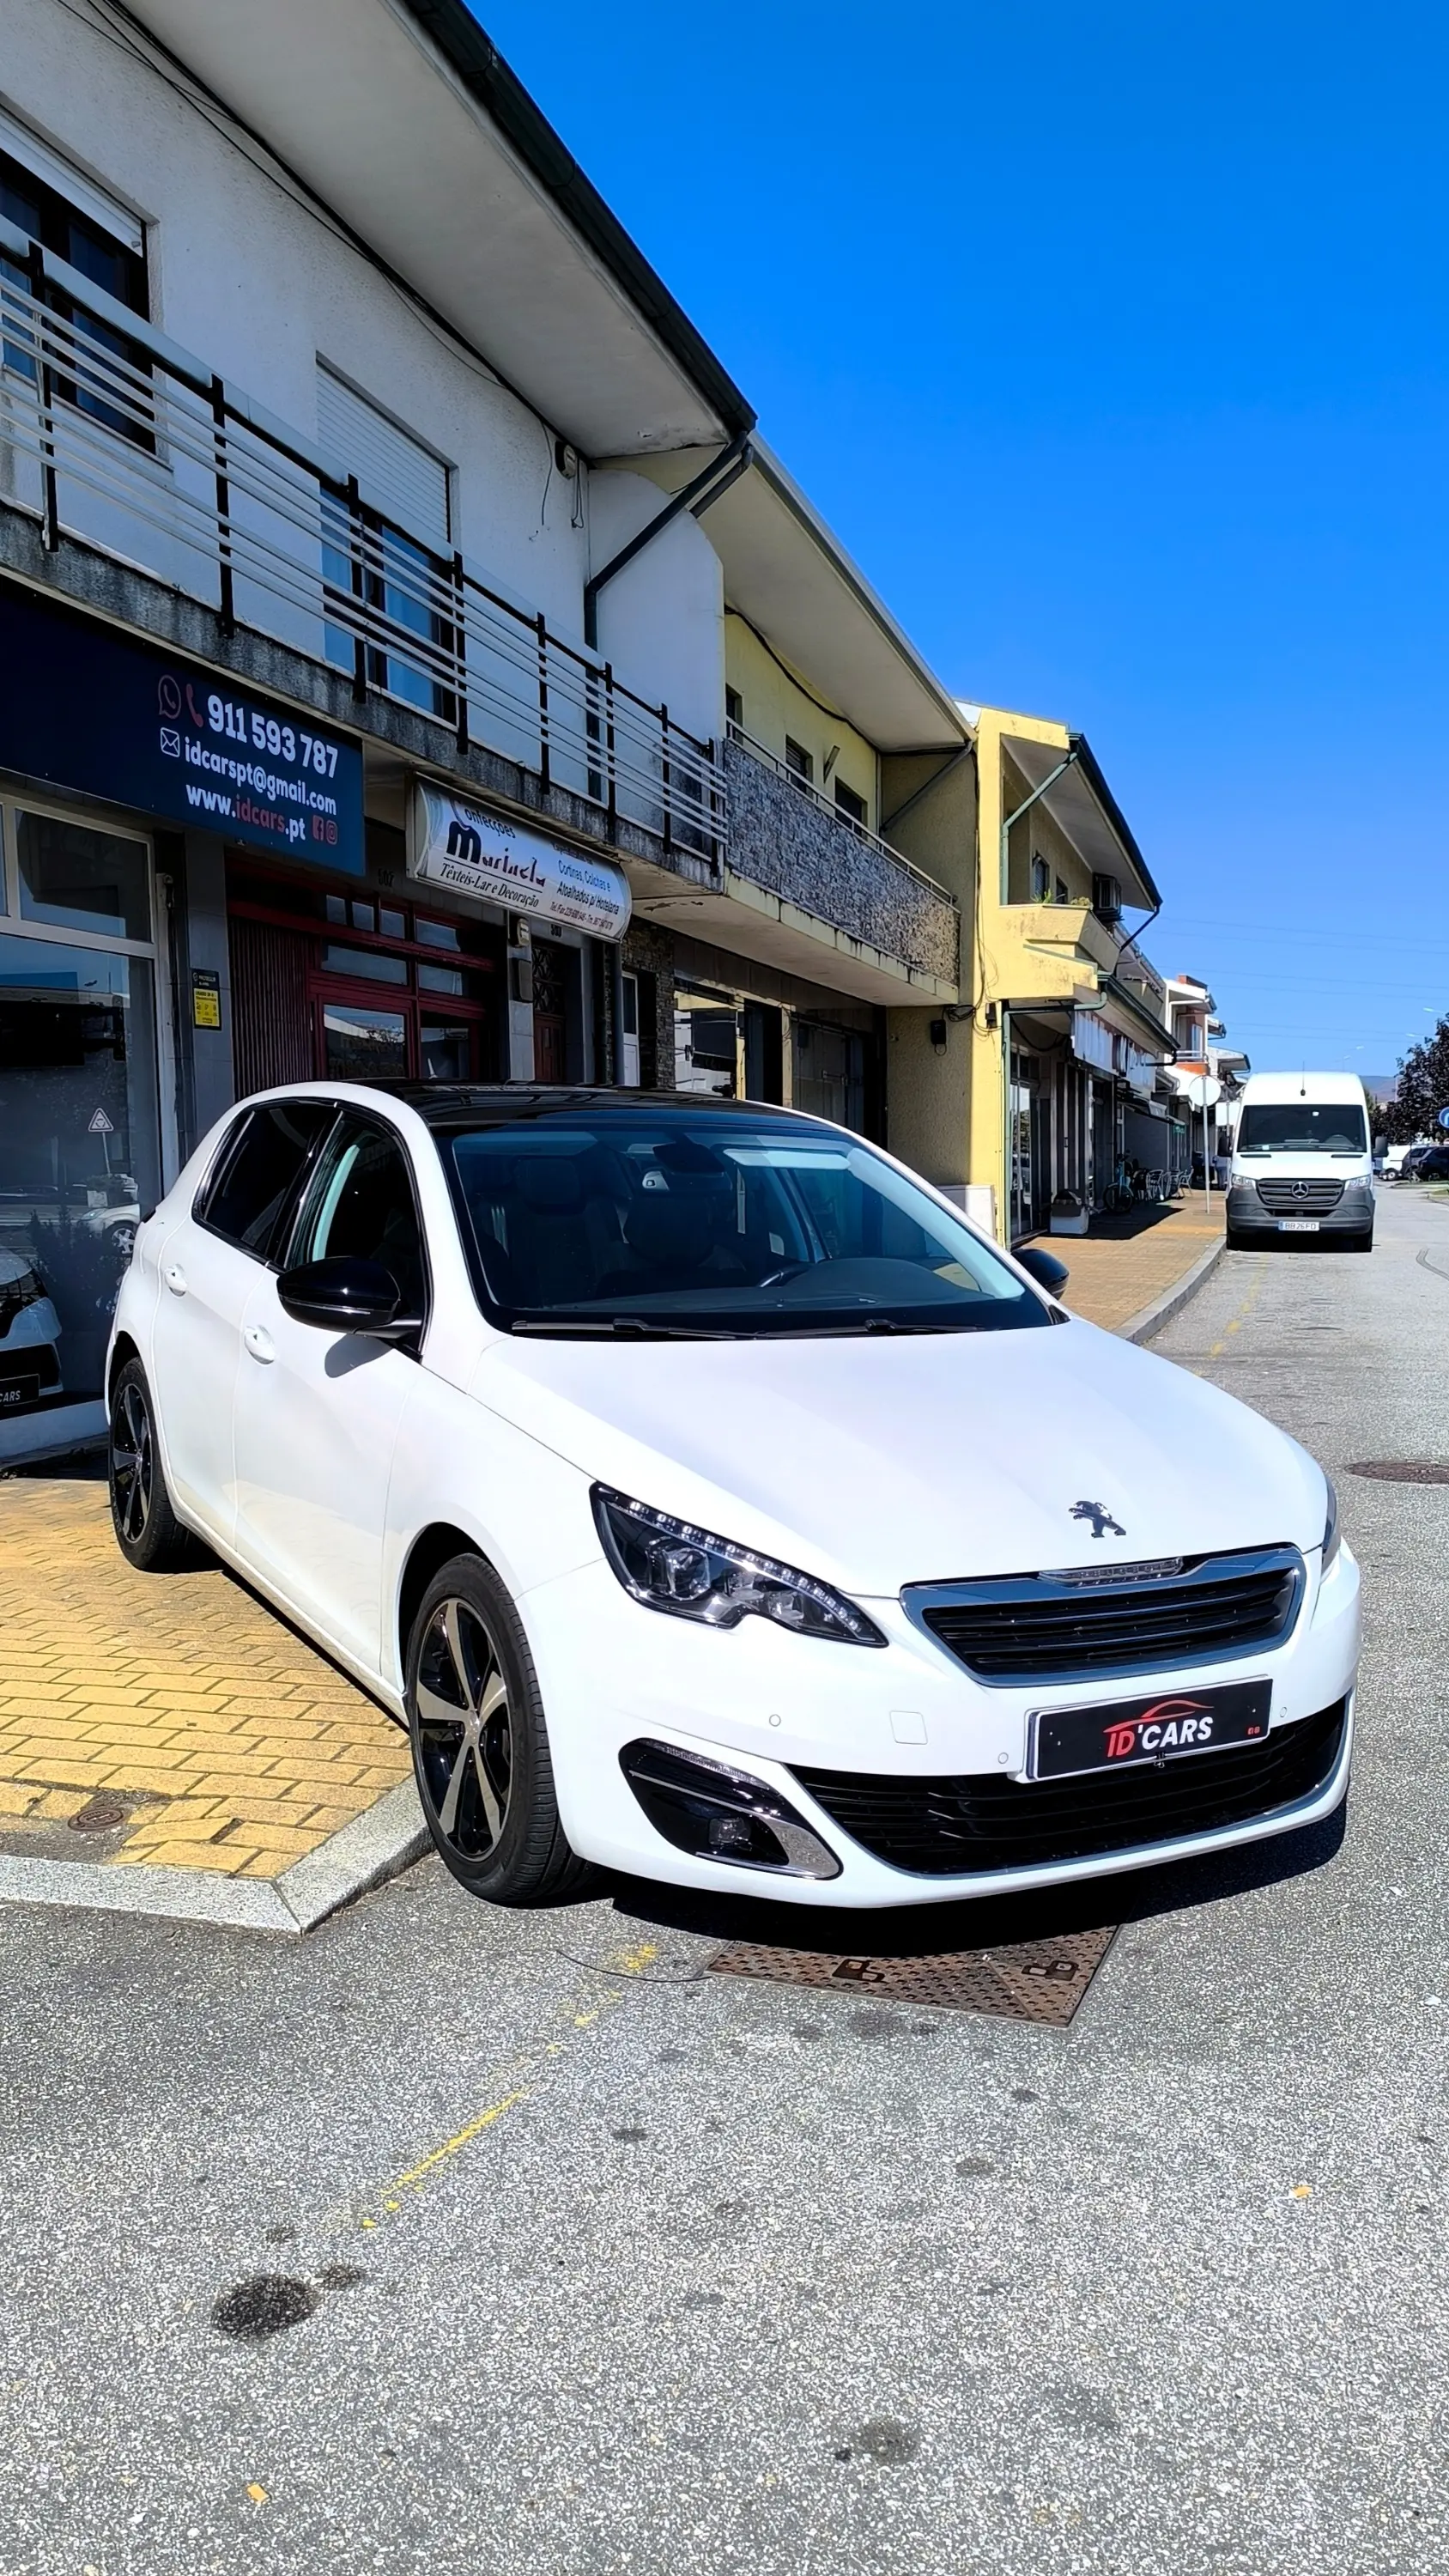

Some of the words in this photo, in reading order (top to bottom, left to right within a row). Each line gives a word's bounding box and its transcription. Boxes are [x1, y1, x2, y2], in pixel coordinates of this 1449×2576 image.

[208, 695, 247, 744] 911
[252, 711, 295, 762] 593
[300, 732, 338, 779] 787
[185, 737, 337, 816] idcarspt@gmail.com
[185, 784, 306, 843] www.idcars.pt
[440, 862, 490, 893] Têxteis-Lar
[491, 884, 498, 894] e
[497, 884, 540, 908] Decoração
[1106, 1716, 1214, 1758] ID'CARS
